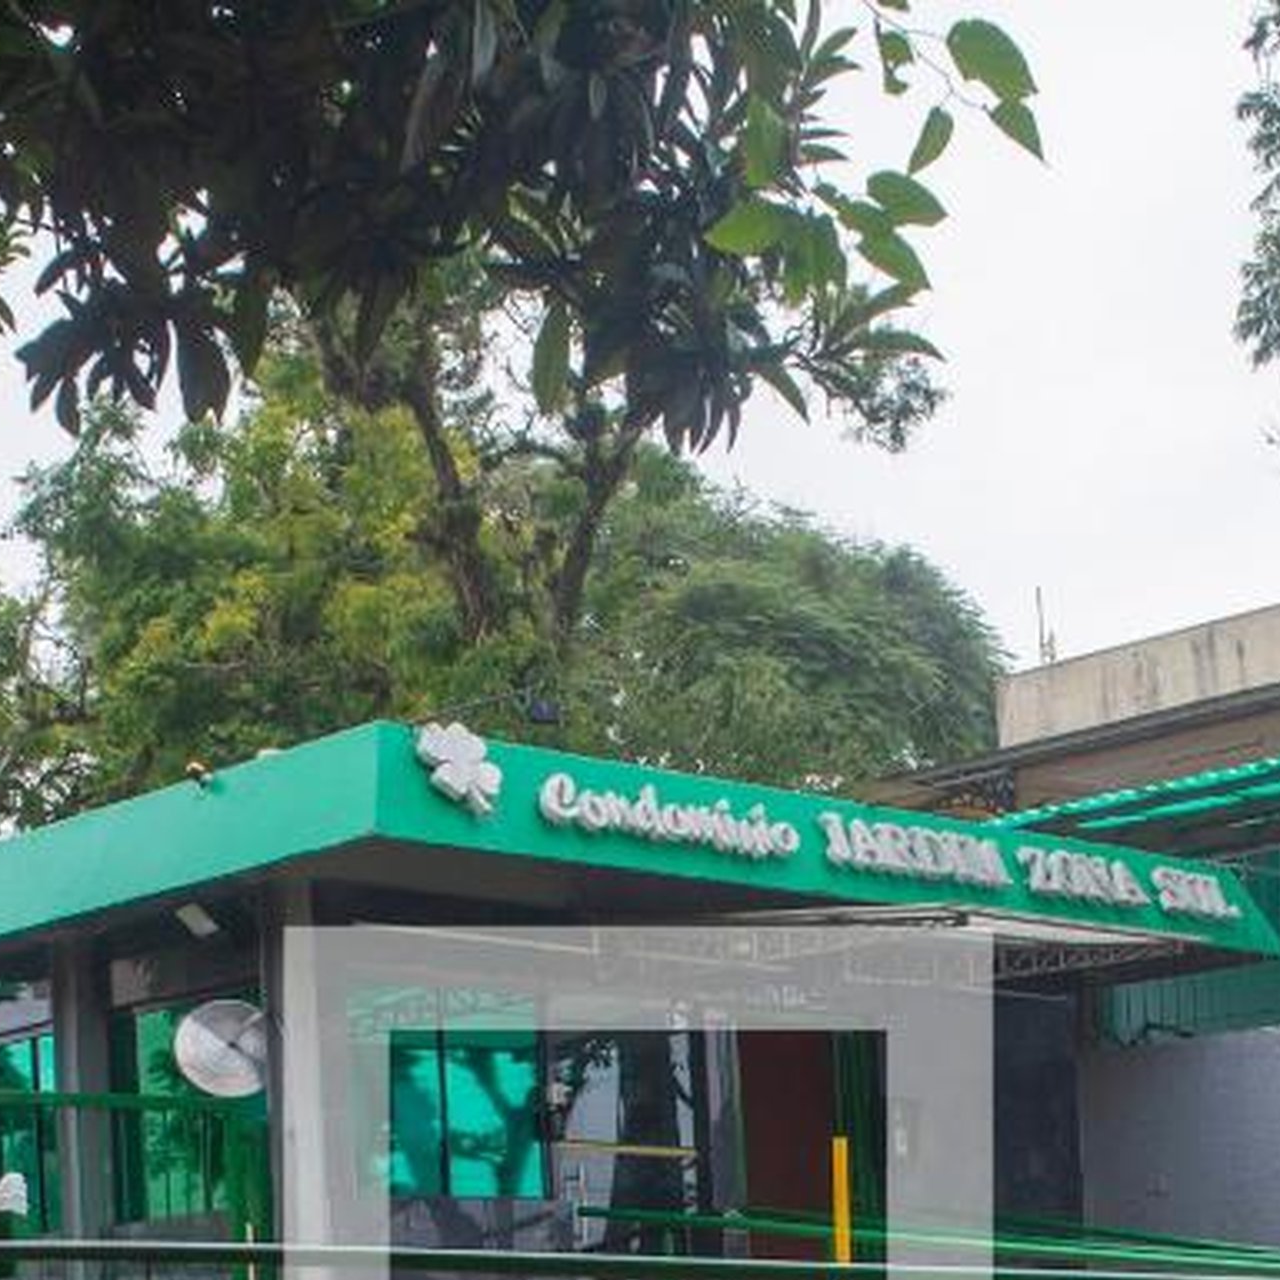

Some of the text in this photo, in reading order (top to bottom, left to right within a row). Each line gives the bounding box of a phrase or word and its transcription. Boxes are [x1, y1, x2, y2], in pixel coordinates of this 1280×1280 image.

[818, 811, 1014, 887] JARDIM
[1017, 845, 1151, 906] ZONA
[1151, 865, 1242, 919] SUL
